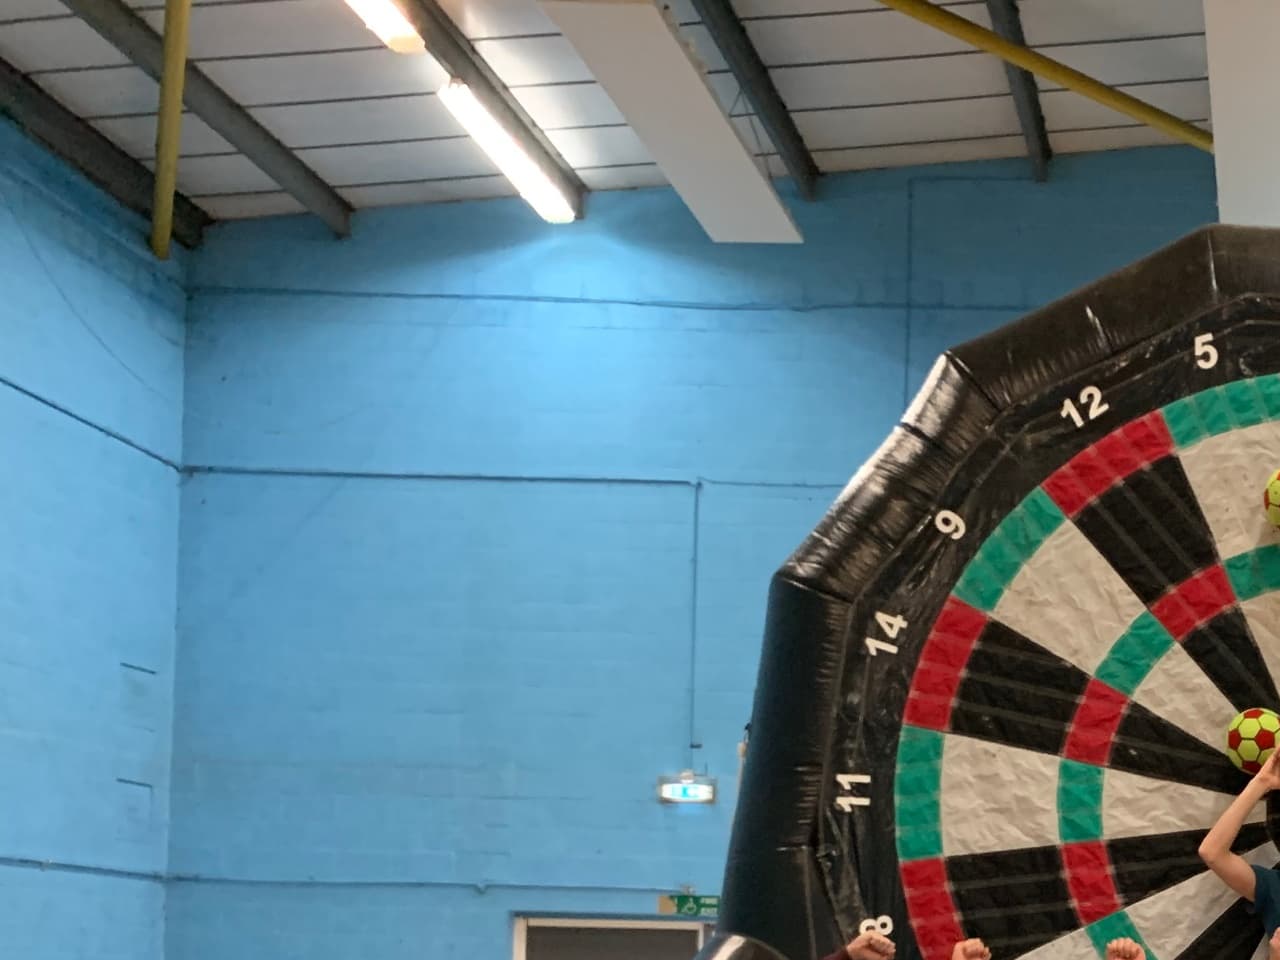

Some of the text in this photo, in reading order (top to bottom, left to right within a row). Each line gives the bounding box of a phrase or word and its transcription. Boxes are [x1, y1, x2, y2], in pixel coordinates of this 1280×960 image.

[1193, 332, 1219, 370] 5
[1060, 386, 1110, 428] 12
[934, 509, 967, 540] 9
[865, 611, 908, 656] 14
[836, 773, 871, 813] 11
[859, 915, 894, 936] 8
